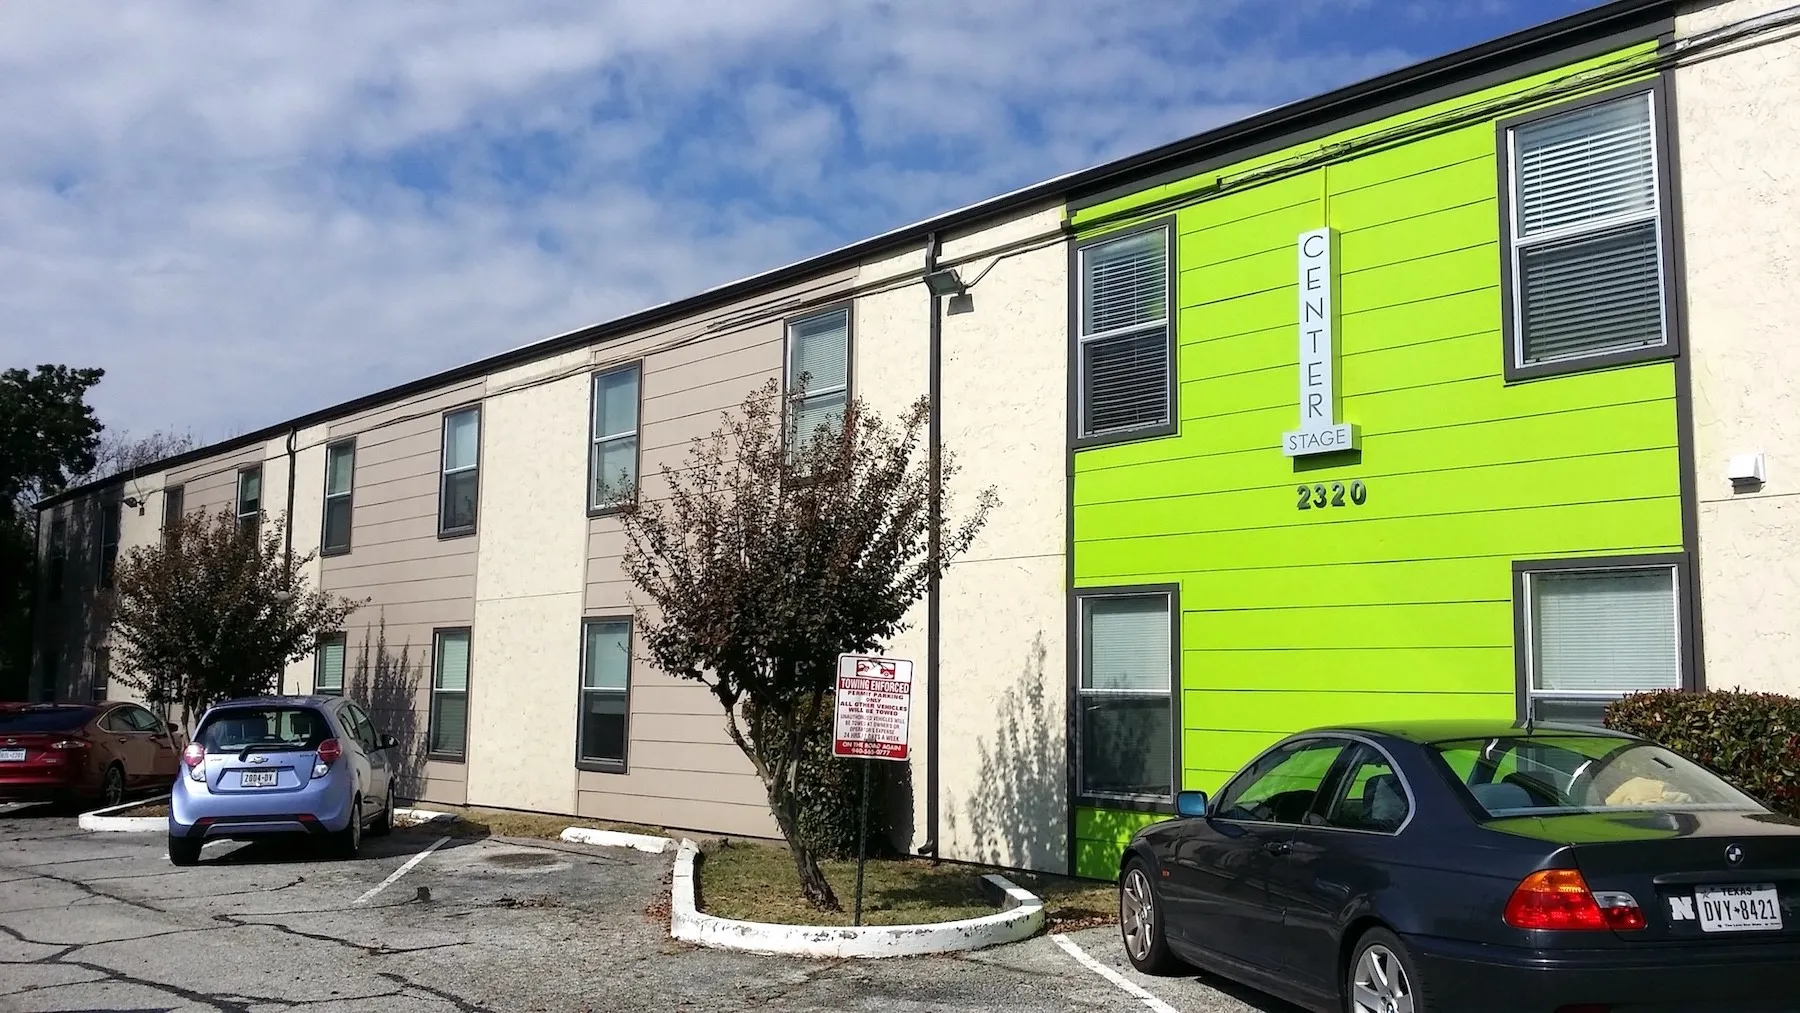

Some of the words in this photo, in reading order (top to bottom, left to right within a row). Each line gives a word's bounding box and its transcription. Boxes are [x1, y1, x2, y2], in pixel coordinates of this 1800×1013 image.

[1303, 235, 1324, 419] CENTER
[1288, 428, 1346, 451] STAGE
[1296, 479, 1367, 511] 2320
[841, 678, 870, 690] TOWING
[870, 680, 909, 693] ENFORCED
[873, 692, 904, 700] PARKING
[1719, 886, 1753, 897] TEXAS
[1668, 896, 1696, 920] N
